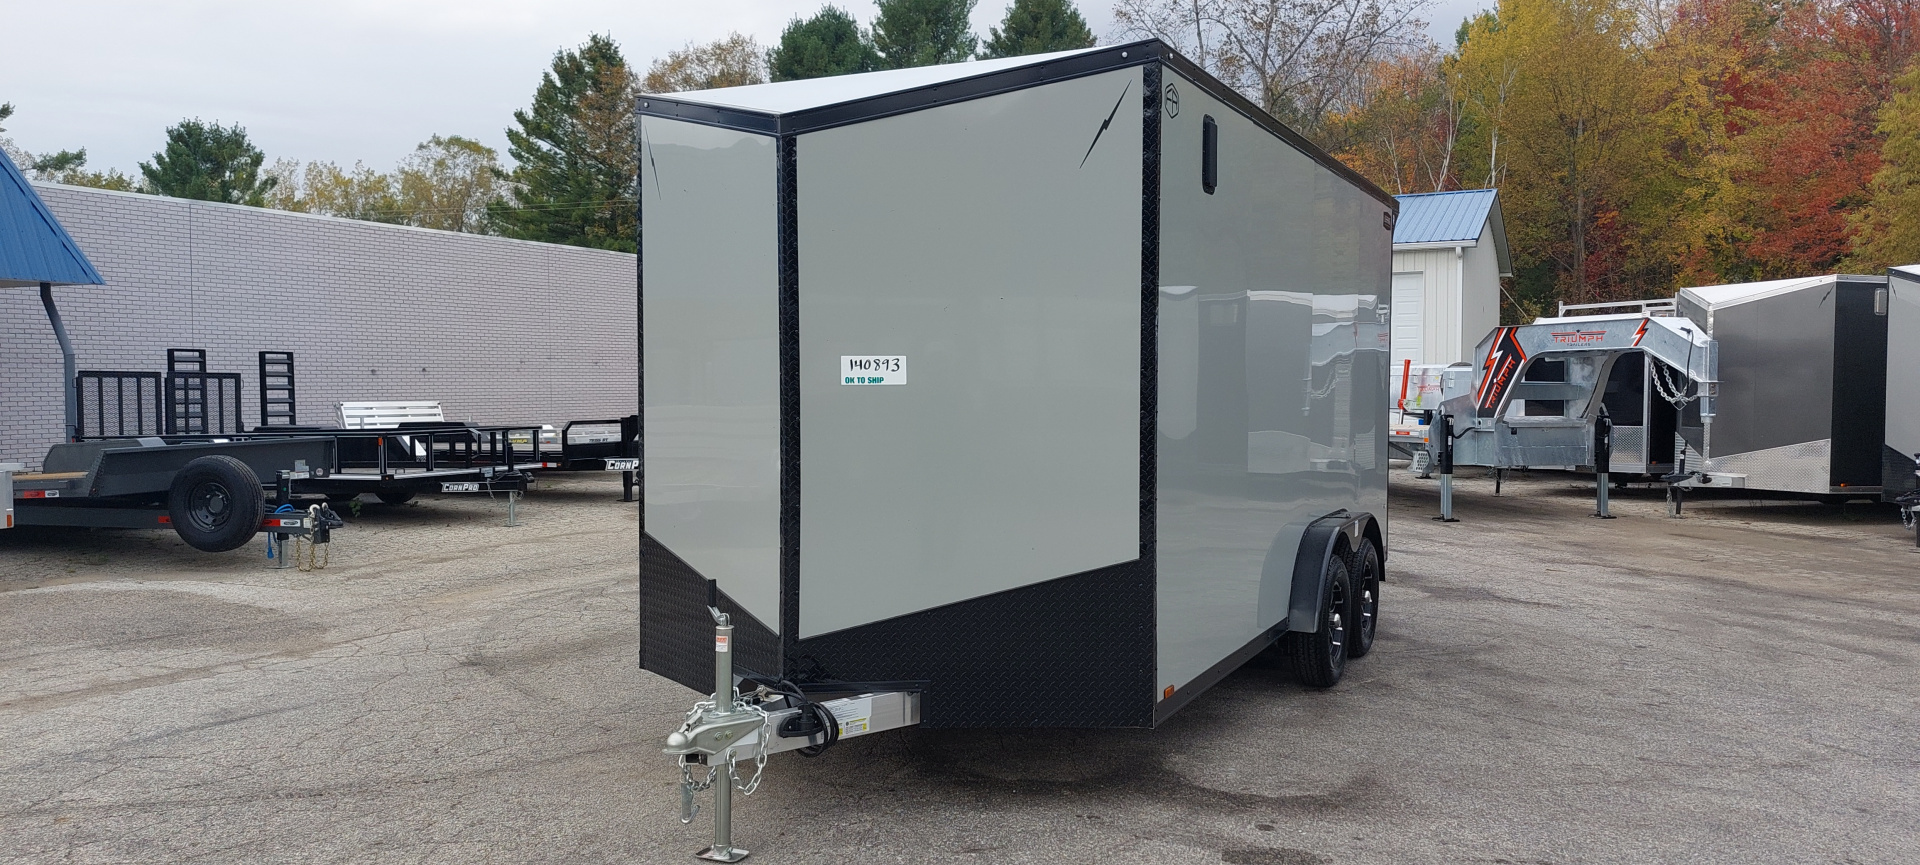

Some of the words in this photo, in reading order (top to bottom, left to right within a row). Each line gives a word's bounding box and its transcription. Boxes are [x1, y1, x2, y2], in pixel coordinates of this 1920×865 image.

[1553, 334, 1604, 343] TRIUMPH
[849, 358, 900, 372] 140893
[844, 376, 855, 384] OK
[857, 376, 866, 384] TO
[867, 376, 884, 384] SHIP
[1487, 358, 1516, 409] TRIUMPH
